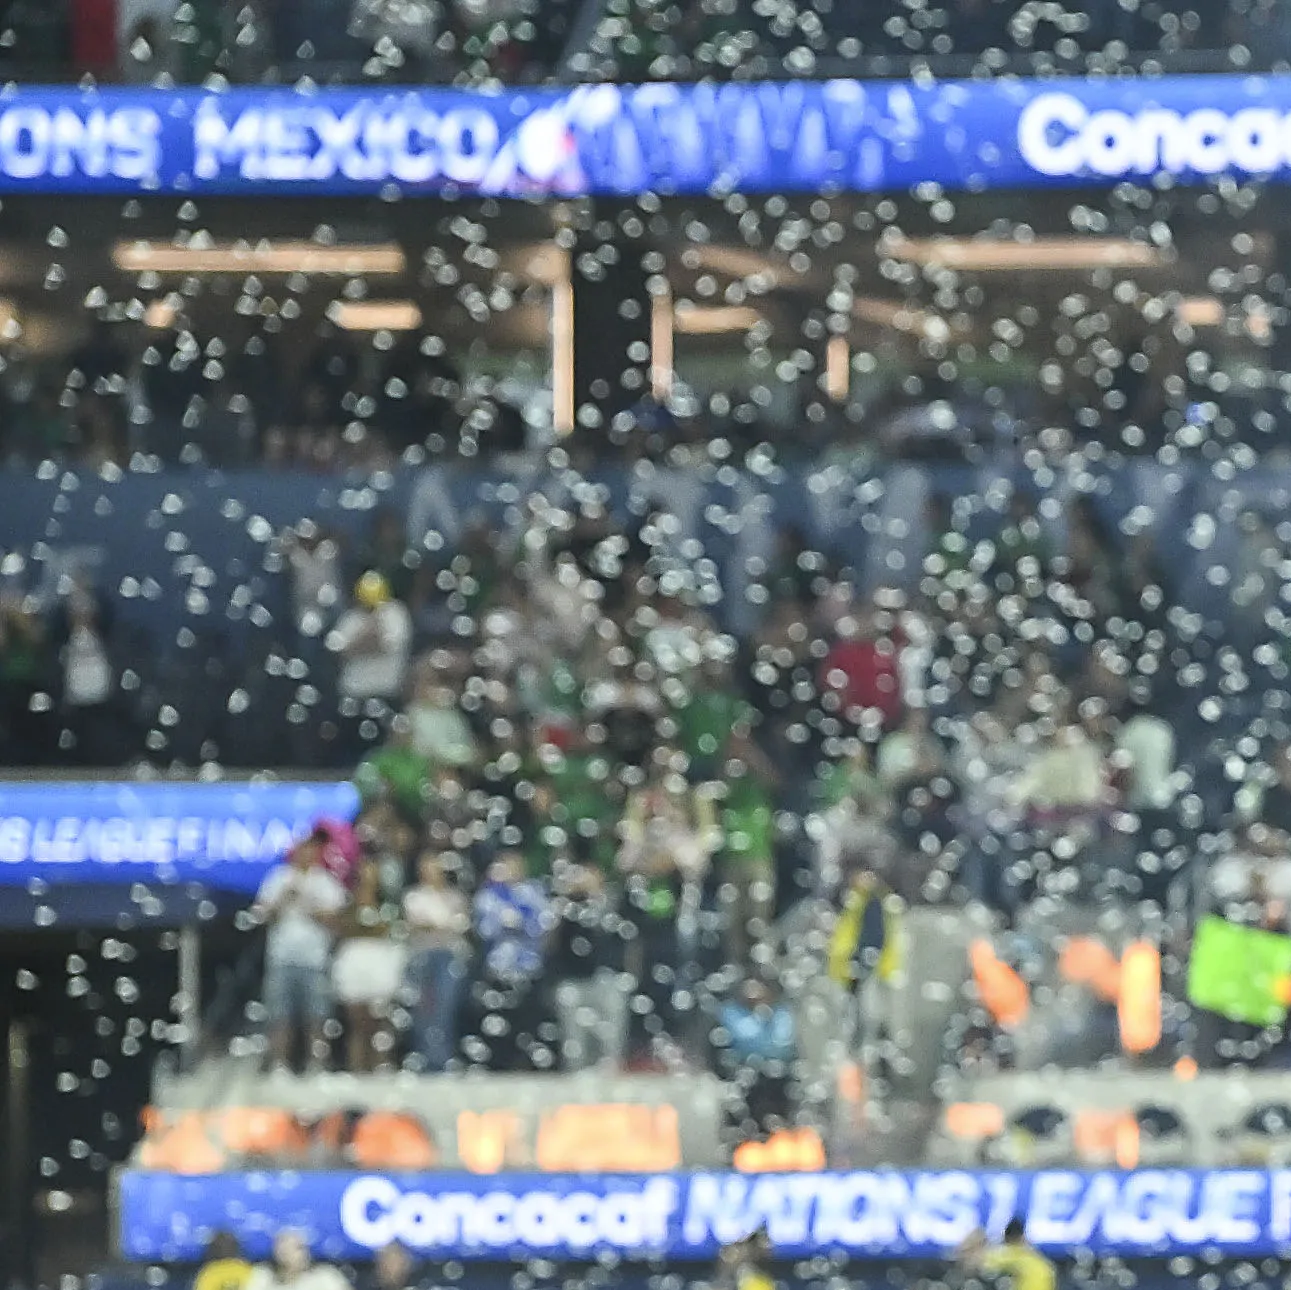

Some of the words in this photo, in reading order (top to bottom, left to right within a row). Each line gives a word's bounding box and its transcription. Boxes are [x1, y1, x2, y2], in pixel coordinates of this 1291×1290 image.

[0, 108, 160, 178] ONS
[197, 107, 499, 182] MEXICO
[339, 1176, 674, 1247] Concacaf
[684, 1172, 981, 1247] NATIONS
[983, 1170, 1265, 1246] LEAGUE
